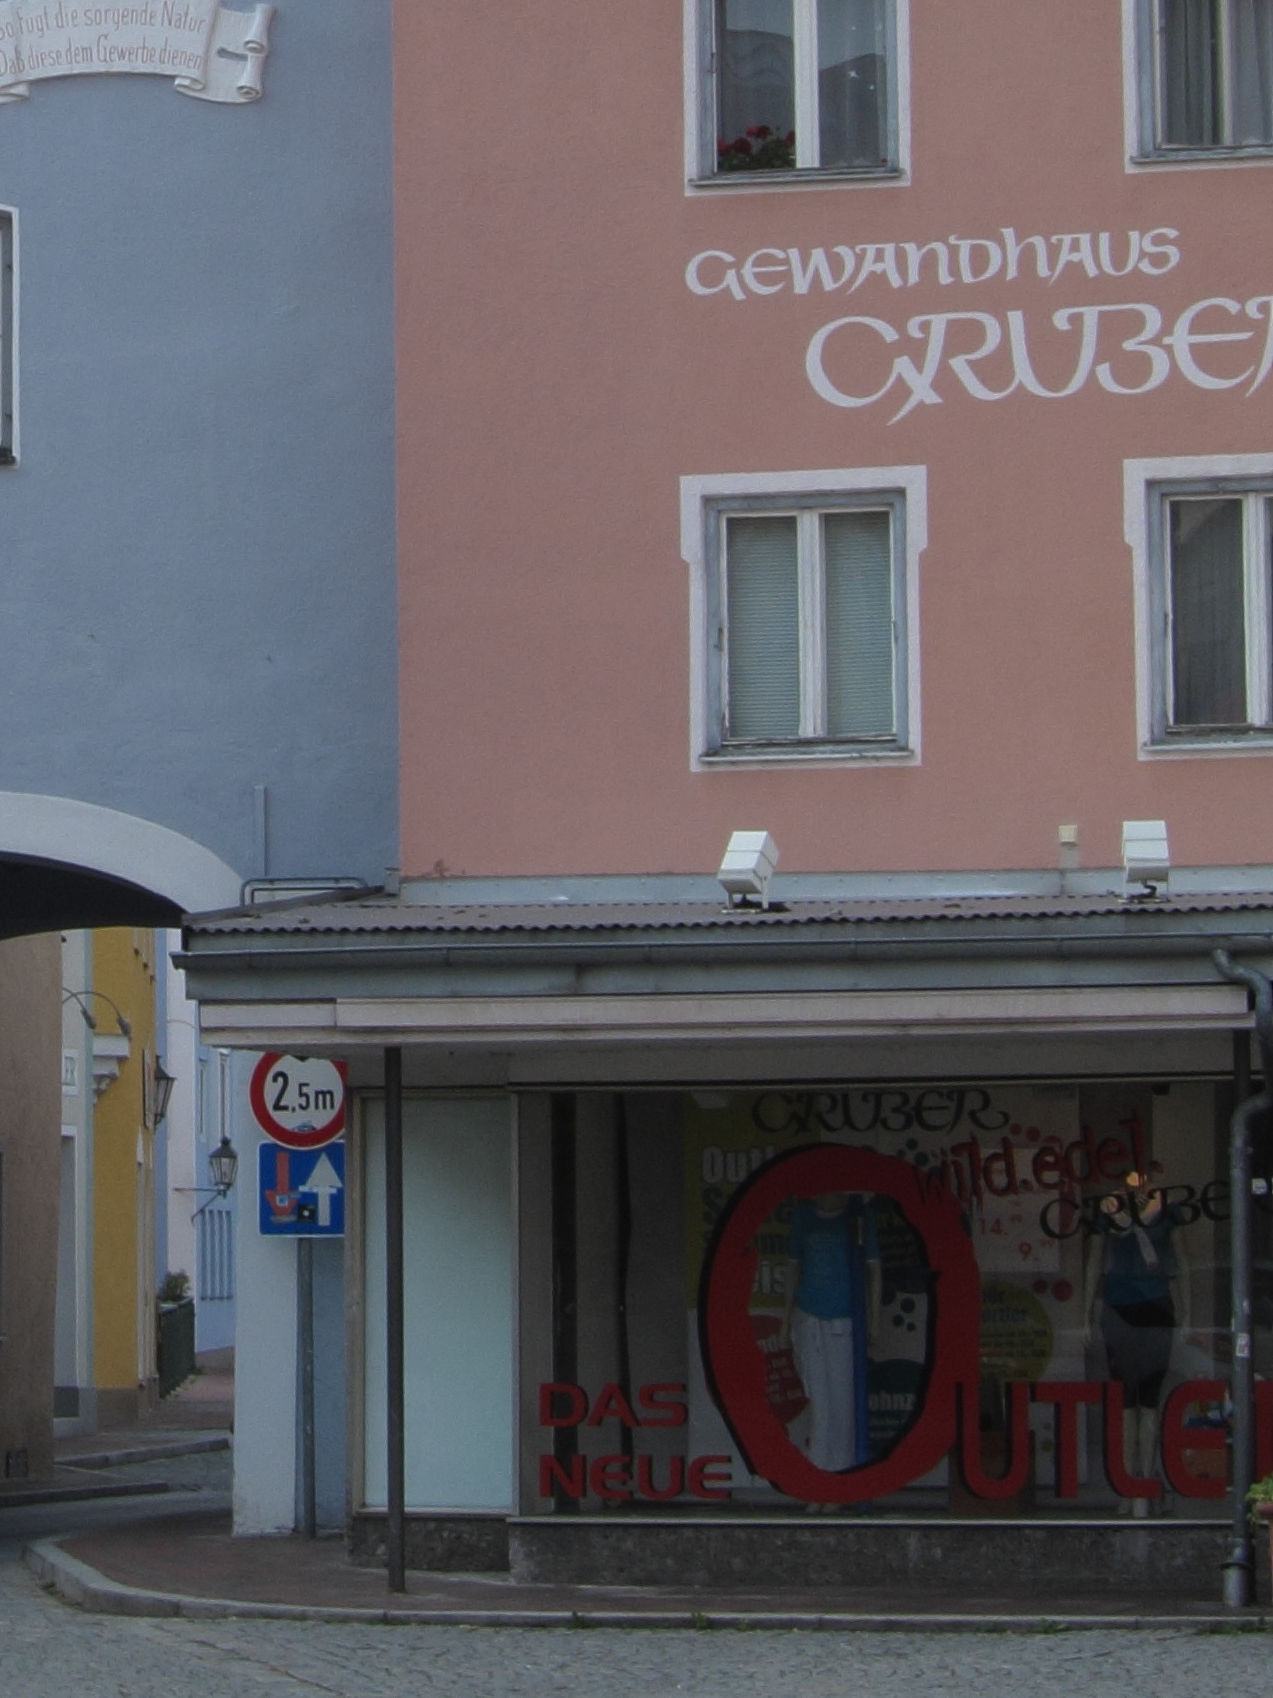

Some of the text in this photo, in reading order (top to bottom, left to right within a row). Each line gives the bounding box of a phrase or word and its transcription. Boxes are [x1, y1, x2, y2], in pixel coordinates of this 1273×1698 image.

[55, 1, 79, 29] die
[83, 0, 157, 31] sorgende
[161, 0, 207, 33] Natur
[27, 42, 63, 70] diese
[65, 37, 94, 65] dem
[97, 33, 157, 64] Gewerbe
[159, 36, 203, 71] dienen
[753, 1088, 1010, 1136] GRUBER
[1040, 1179, 1273, 1239] GRUBE
[539, 1383, 688, 1428] DAS
[539, 1454, 731, 1500] NEUE
